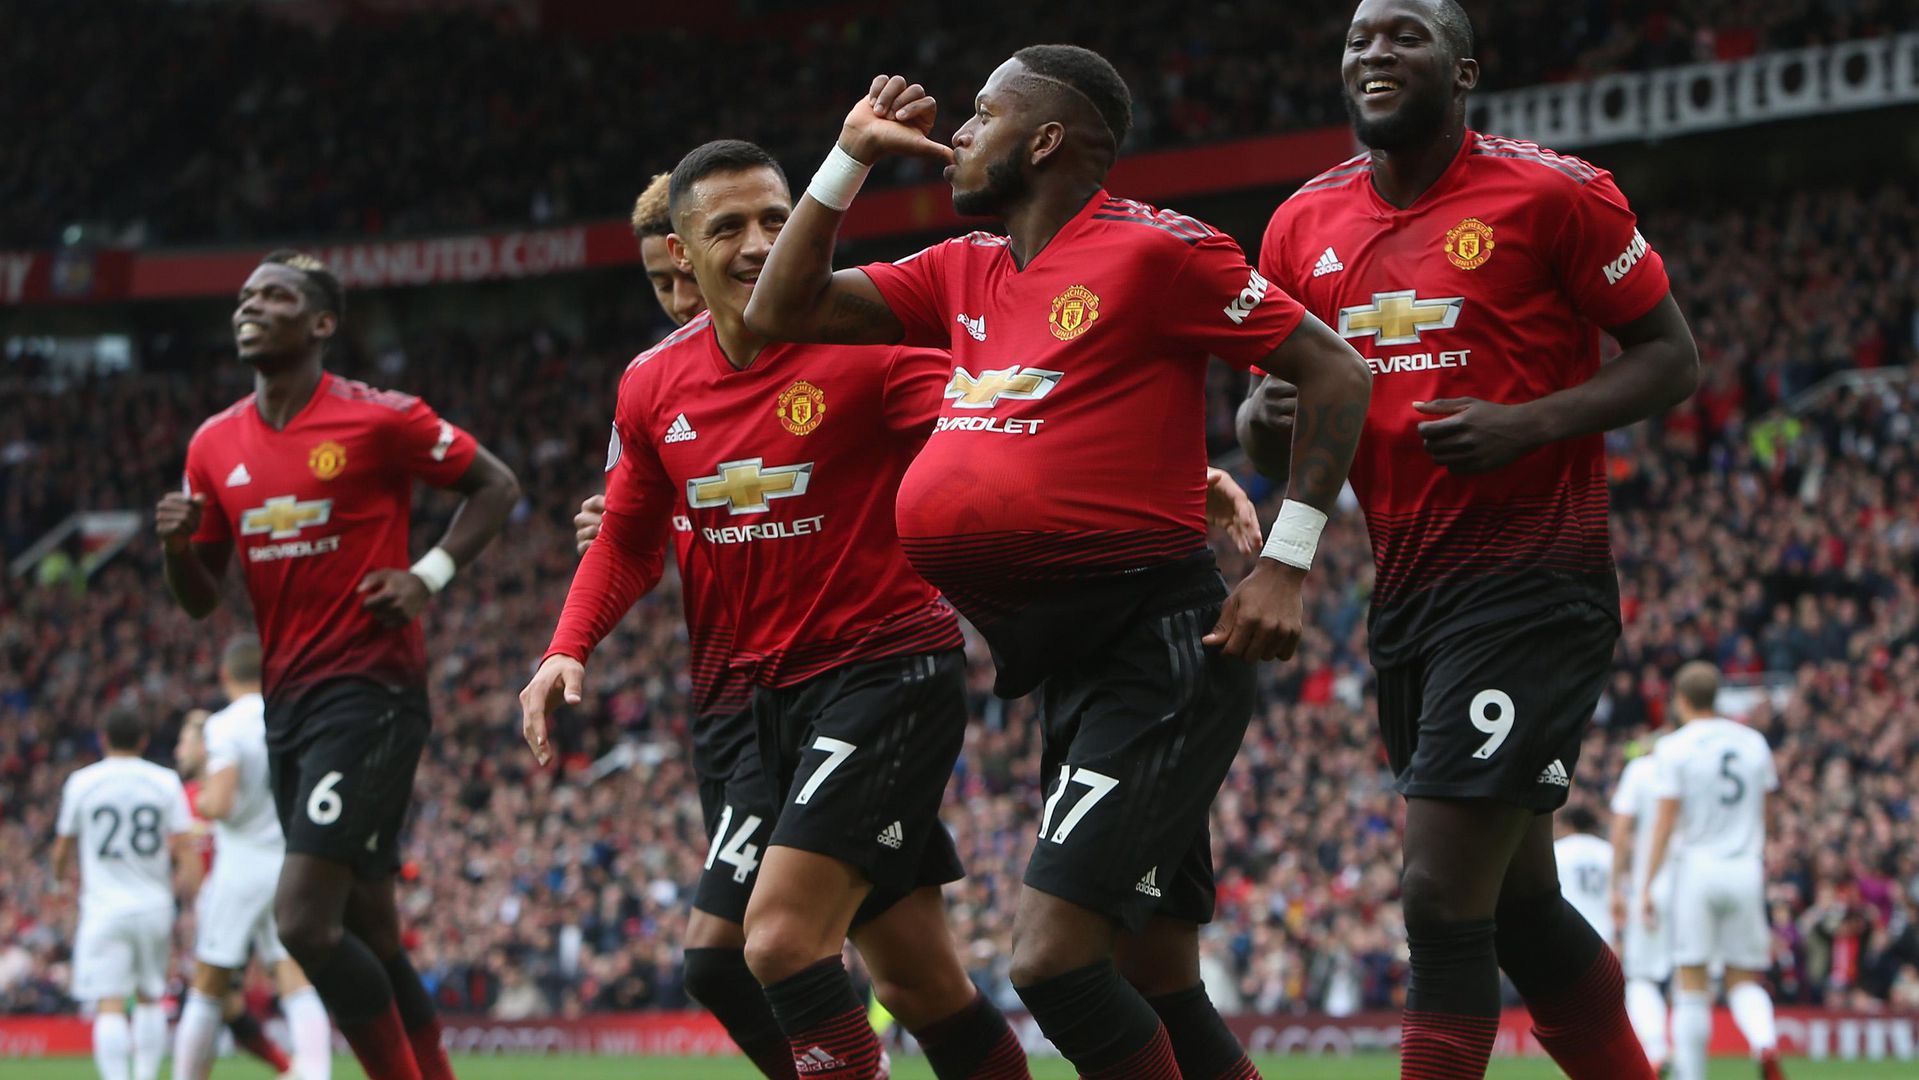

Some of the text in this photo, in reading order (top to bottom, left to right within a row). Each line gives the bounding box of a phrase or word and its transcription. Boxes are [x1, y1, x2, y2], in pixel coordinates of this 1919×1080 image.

[1313, 261, 1344, 278] adidas
[1056, 327, 1085, 337] UNITED
[664, 429, 697, 444] adidas
[702, 515, 825, 544] CHEVROLET
[1469, 688, 1516, 760] 9
[306, 770, 344, 826] 6
[795, 736, 858, 805] 7
[1719, 750, 1746, 808] 5
[92, 804, 161, 858] 28
[1038, 764, 1120, 845] 17
[704, 805, 763, 884] 14
[1135, 880, 1162, 898] adidas
